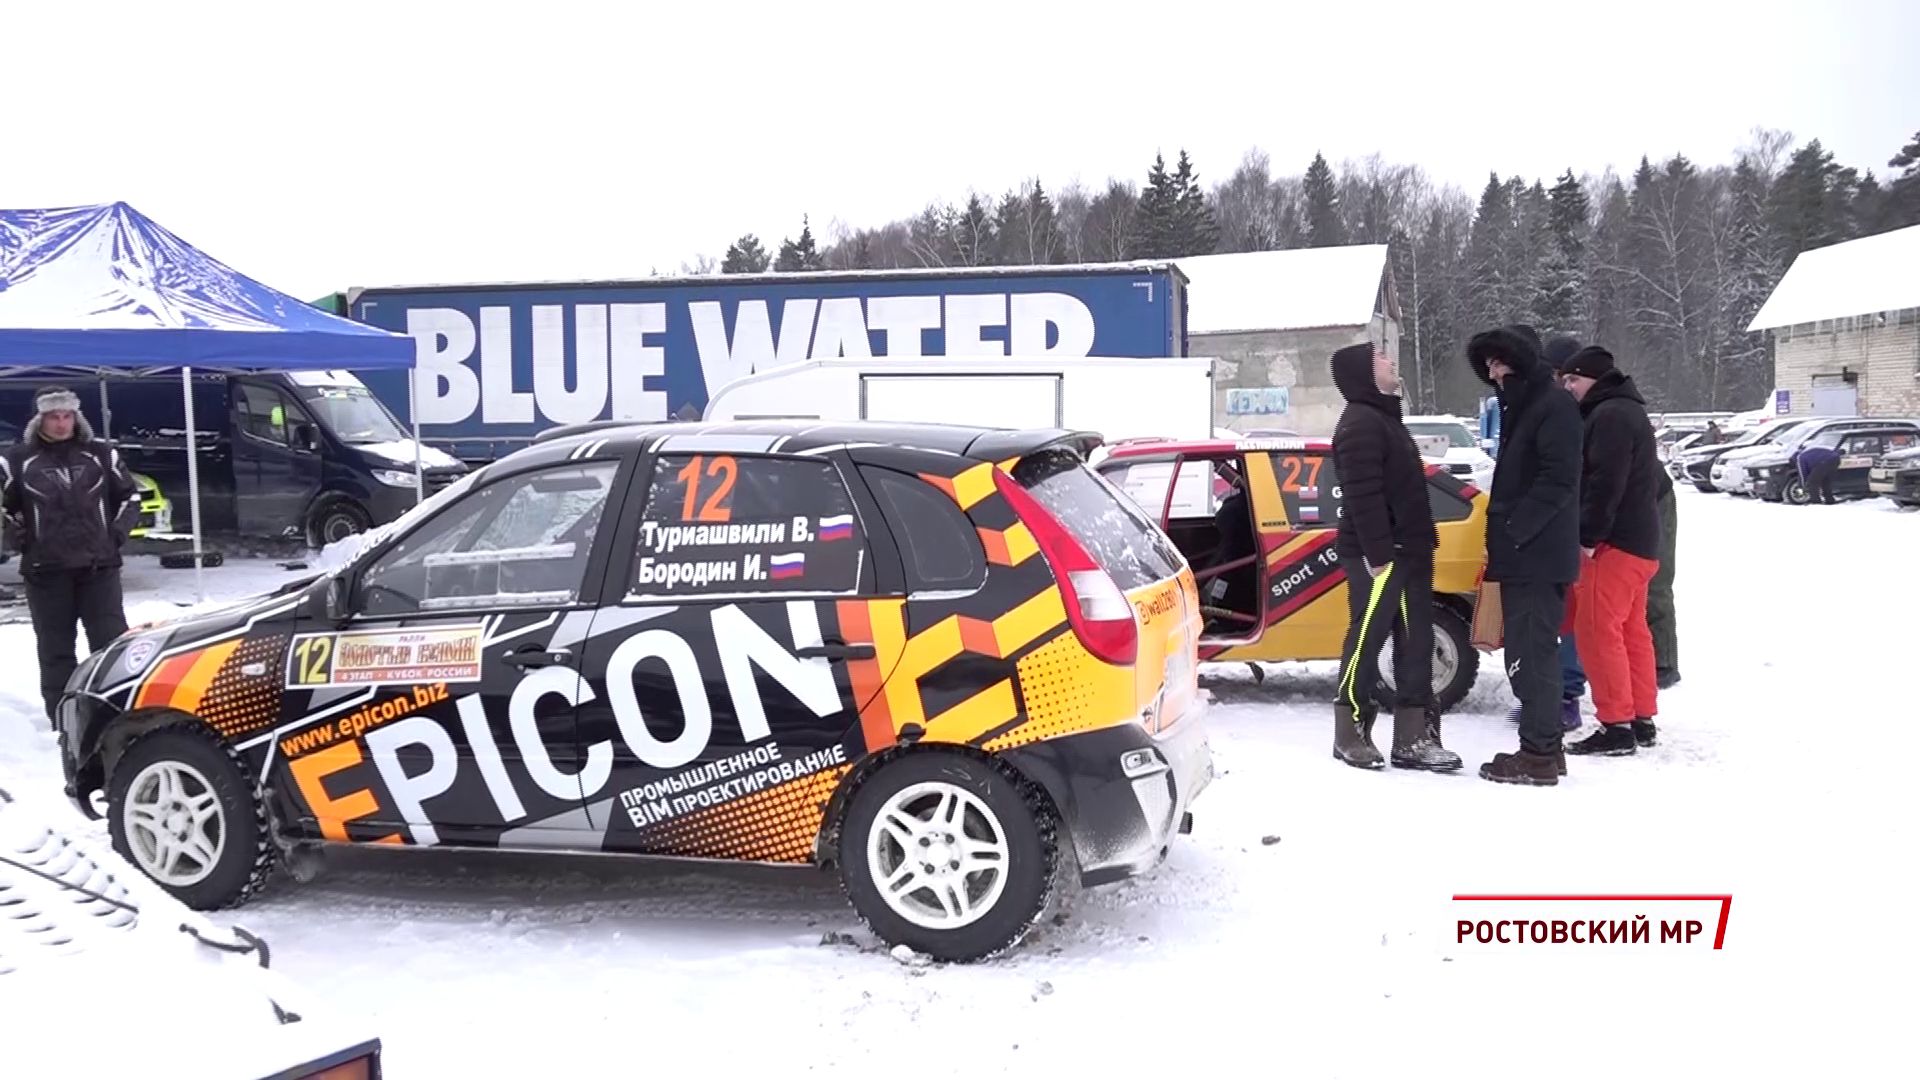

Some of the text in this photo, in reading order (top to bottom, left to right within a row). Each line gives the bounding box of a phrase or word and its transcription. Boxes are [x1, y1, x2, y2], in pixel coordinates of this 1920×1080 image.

[407, 301, 667, 425] BLUE
[677, 455, 738, 522] 12
[1282, 456, 1324, 492] 27
[642, 516, 815, 553] Туриашвили В.
[638, 553, 767, 589] Бородин И.
[1271, 564, 1314, 596] sport
[295, 636, 331, 684] 12
[349, 671, 374, 681] ЭТАП
[386, 669, 422, 680] КУБОК
[426, 667, 473, 679] РОССИИ
[279, 681, 449, 757] www.epicon.biz
[289, 600, 843, 847] EPICON
[619, 741, 782, 809] ПРОМЫШЛЕННОЕ
[627, 743, 847, 829] BIM ПРОЕКТИРОВАНИЕ
